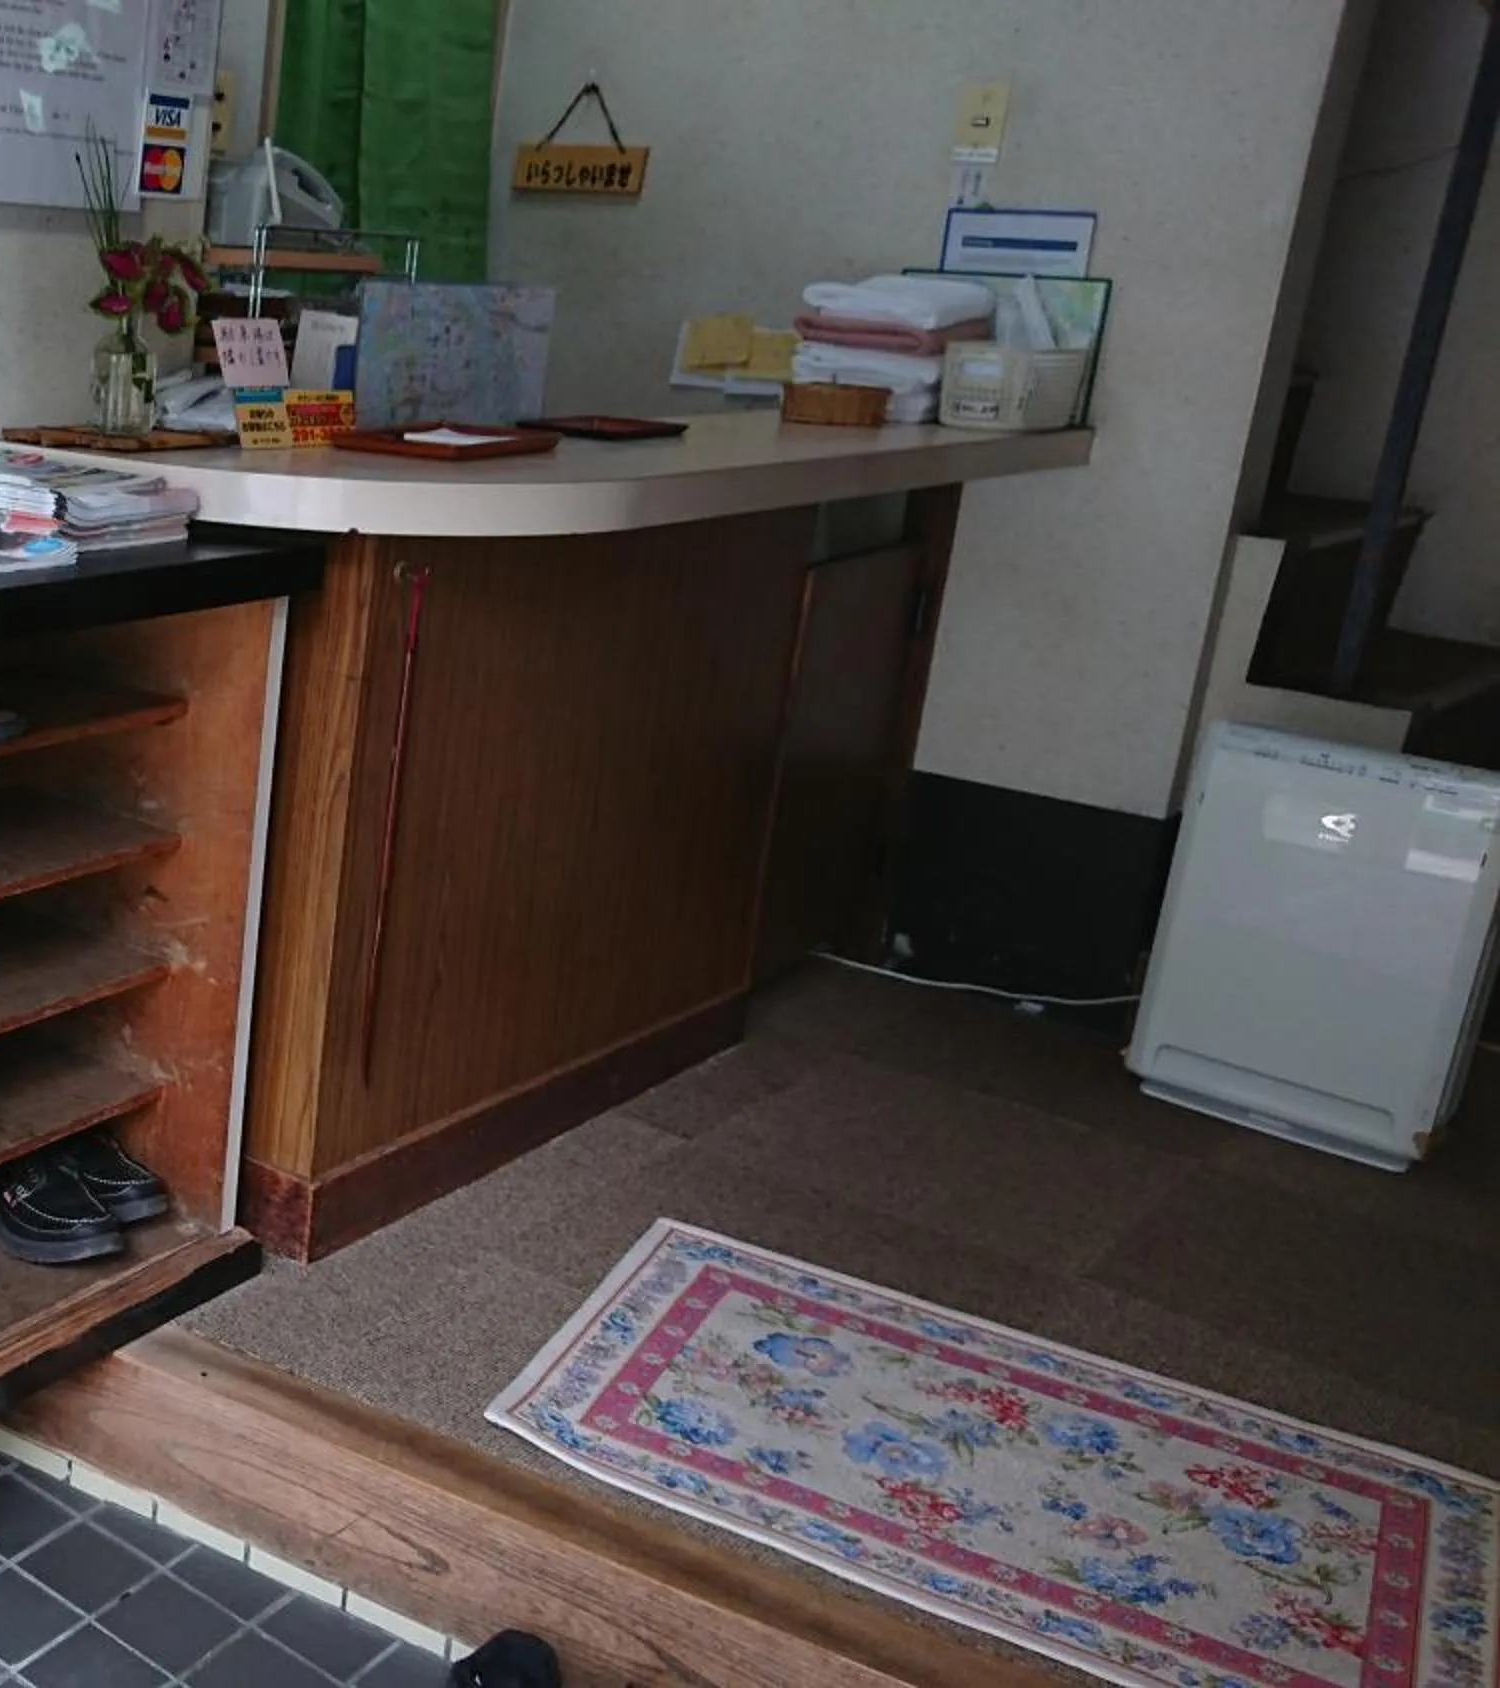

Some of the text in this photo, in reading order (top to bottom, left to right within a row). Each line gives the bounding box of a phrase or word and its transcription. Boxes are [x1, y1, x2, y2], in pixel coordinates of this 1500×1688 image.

[154, 108, 181, 127] VISA
[526, 160, 632, 188] いらっしゃいませ
